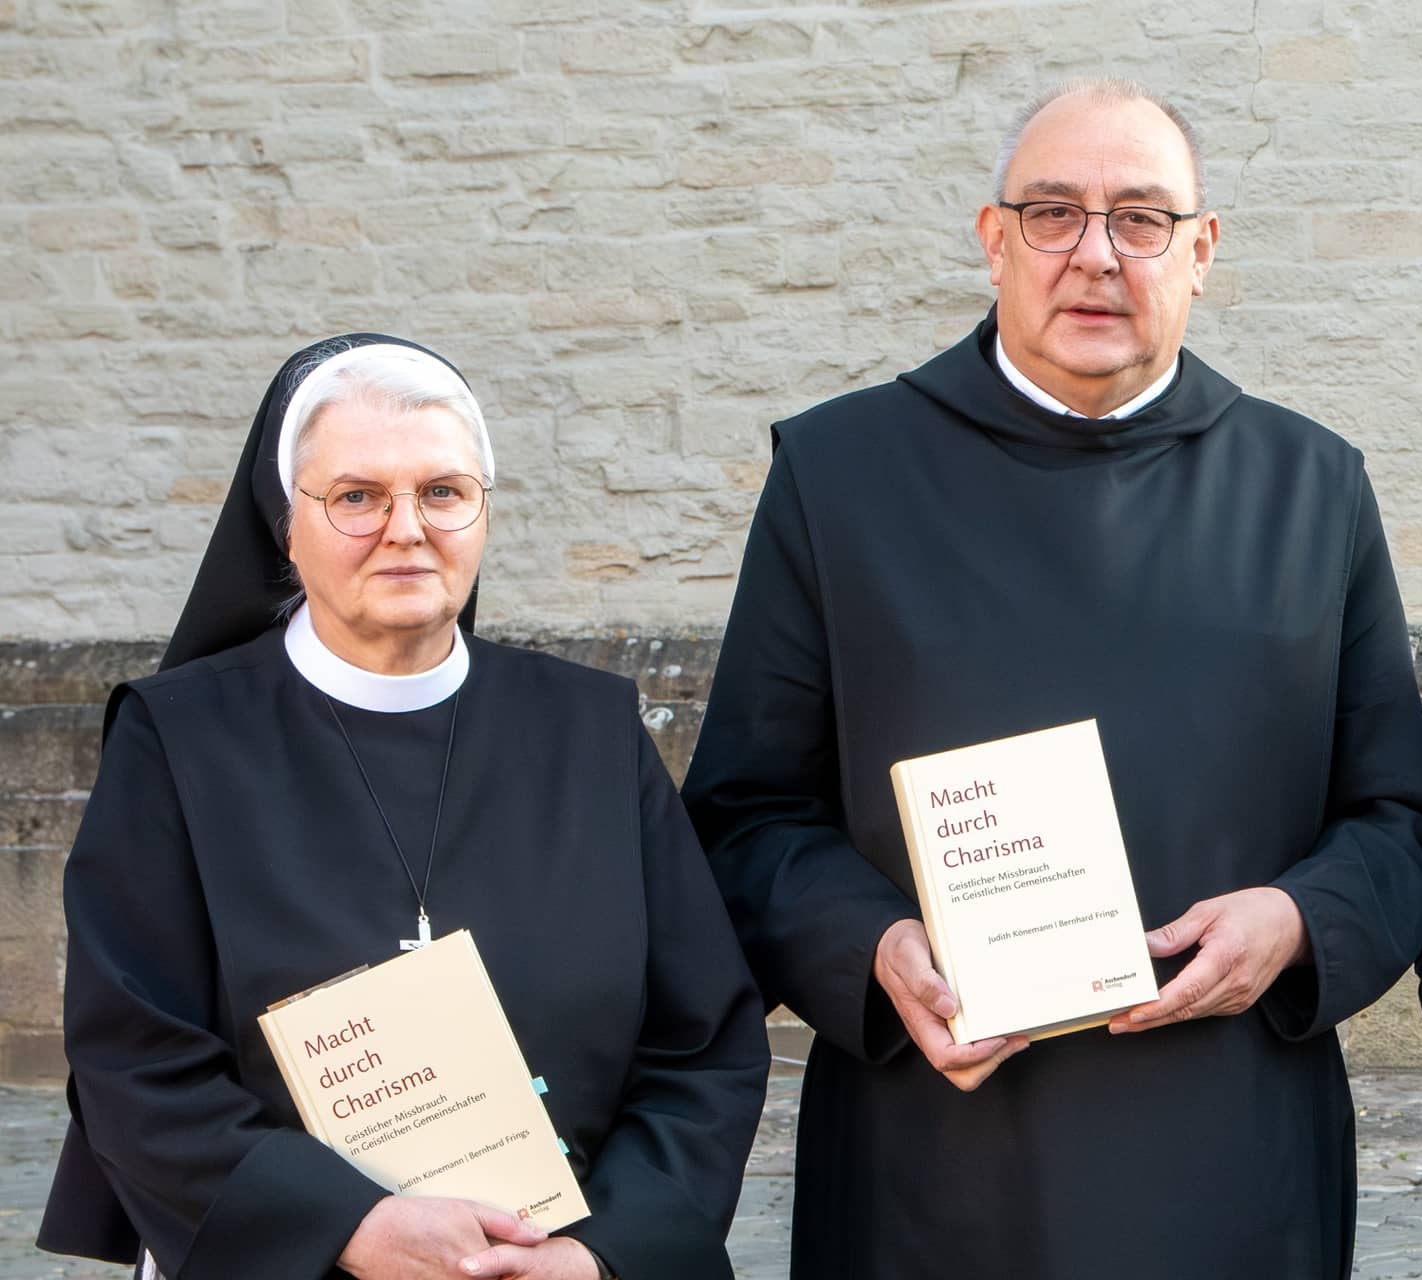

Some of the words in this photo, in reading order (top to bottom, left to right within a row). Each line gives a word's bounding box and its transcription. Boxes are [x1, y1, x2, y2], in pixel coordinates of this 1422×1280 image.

[930, 780, 997, 808] Macht
[937, 810, 997, 838] durch
[943, 835, 1044, 868] Charisma
[948, 874, 996, 892] Geistlicher
[998, 862, 1049, 881] Missbrauch
[951, 894, 960, 903] in
[962, 883, 1012, 901] Geistlichen
[1013, 867, 1086, 889] Gemeinschaften
[988, 932, 1011, 944] Judith
[1013, 923, 1053, 937] Könemann
[1058, 913, 1094, 928] Bernhard
[1095, 908, 1119, 920] Frings
[304, 1017, 375, 1058] Macht
[319, 1049, 383, 1089] durch
[332, 1065, 437, 1119] Charisma
[345, 1118, 393, 1144] Geistlicher
[394, 1093, 448, 1122] Missbrauch
[350, 1145, 360, 1156] in
[361, 1126, 411, 1151] Geistlichen
[413, 1091, 486, 1129] Gemeinschaften
[398, 1174, 422, 1192] Judith
[423, 1159, 464, 1179] Könemann
[469, 1137, 505, 1161] Bernhard
[505, 1130, 530, 1145] Frings
